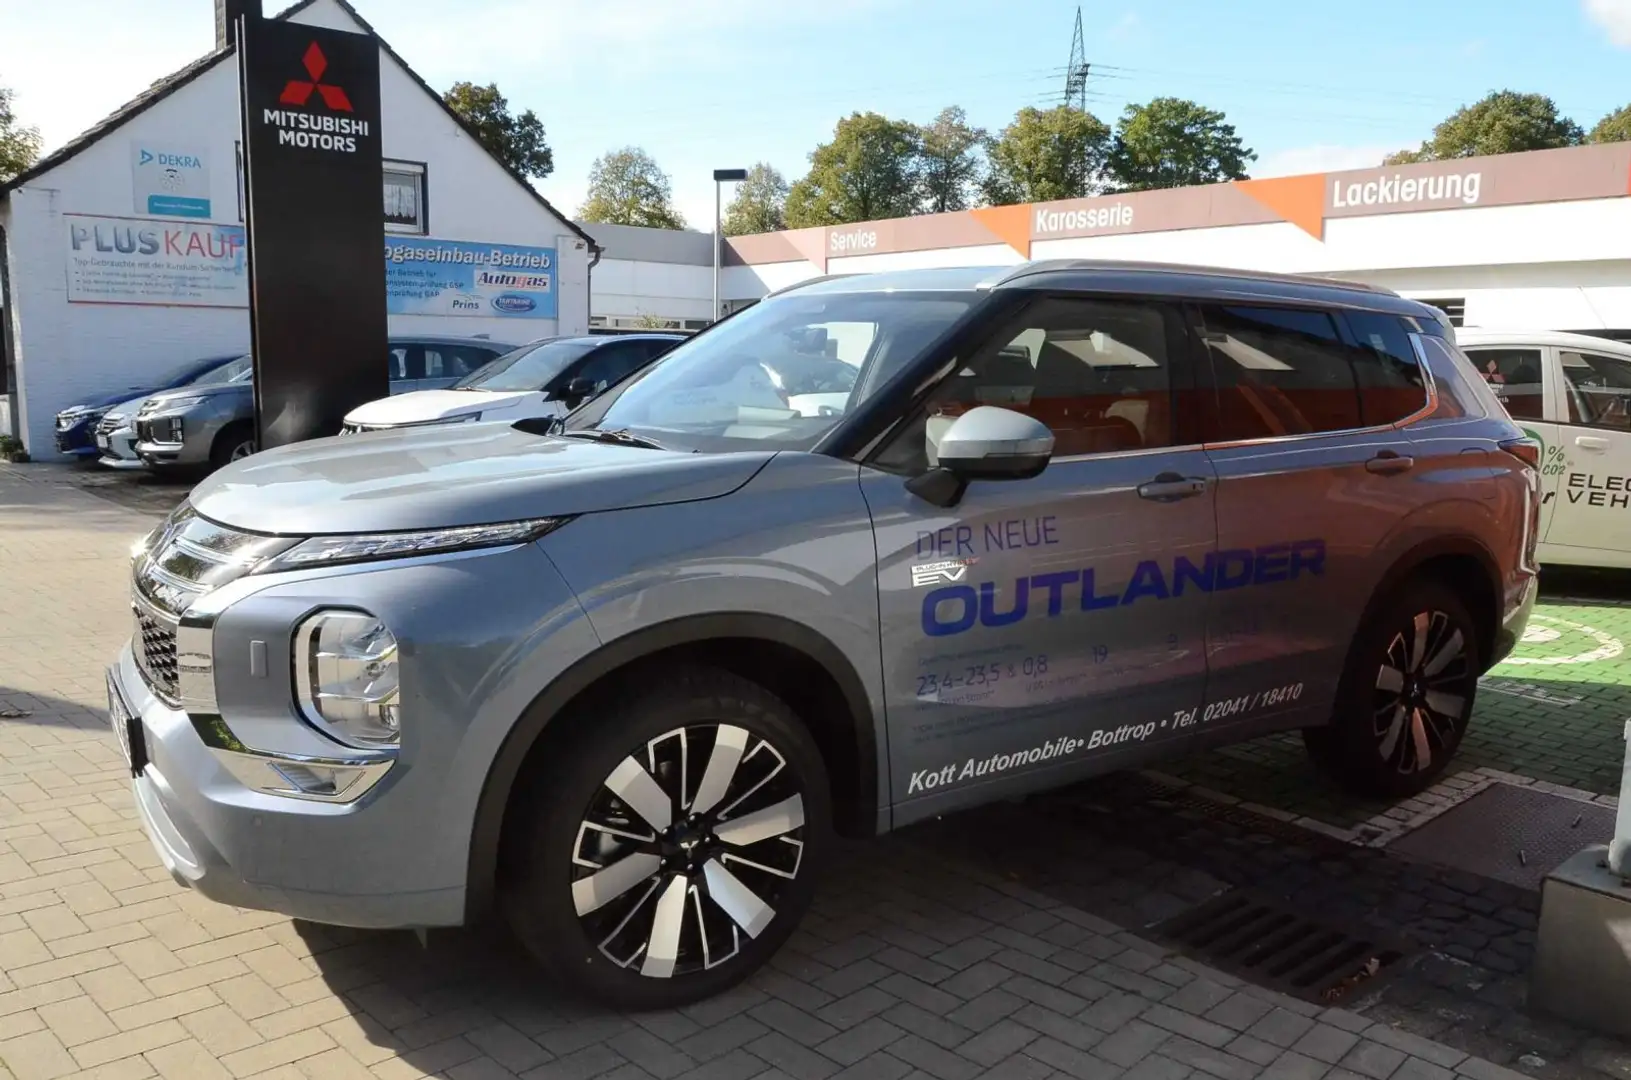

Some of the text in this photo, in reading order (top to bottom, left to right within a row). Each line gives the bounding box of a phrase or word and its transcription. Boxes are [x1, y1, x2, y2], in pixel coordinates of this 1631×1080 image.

[263, 108, 369, 137] MITSUBISHI
[278, 129, 357, 153] MOTORS
[158, 152, 202, 169] DEKRA
[1332, 169, 1484, 209] Lackierung
[1034, 201, 1134, 234] Karosserie
[829, 229, 877, 253] Service
[478, 271, 549, 289] Autogas
[452, 299, 480, 310] Prins
[1542, 464, 1566, 476] CO2
[915, 515, 1060, 561] DER NEUE
[911, 566, 968, 588] EV
[920, 538, 1327, 638] OUTLANDER
[1022, 653, 1048, 679] 0,8
[908, 760, 957, 795] Kott
[1087, 716, 1156, 752] Bottrop
[1171, 709, 1199, 731] Tel.
[1202, 696, 1250, 723] 02041
[1260, 682, 1305, 708] 18410
